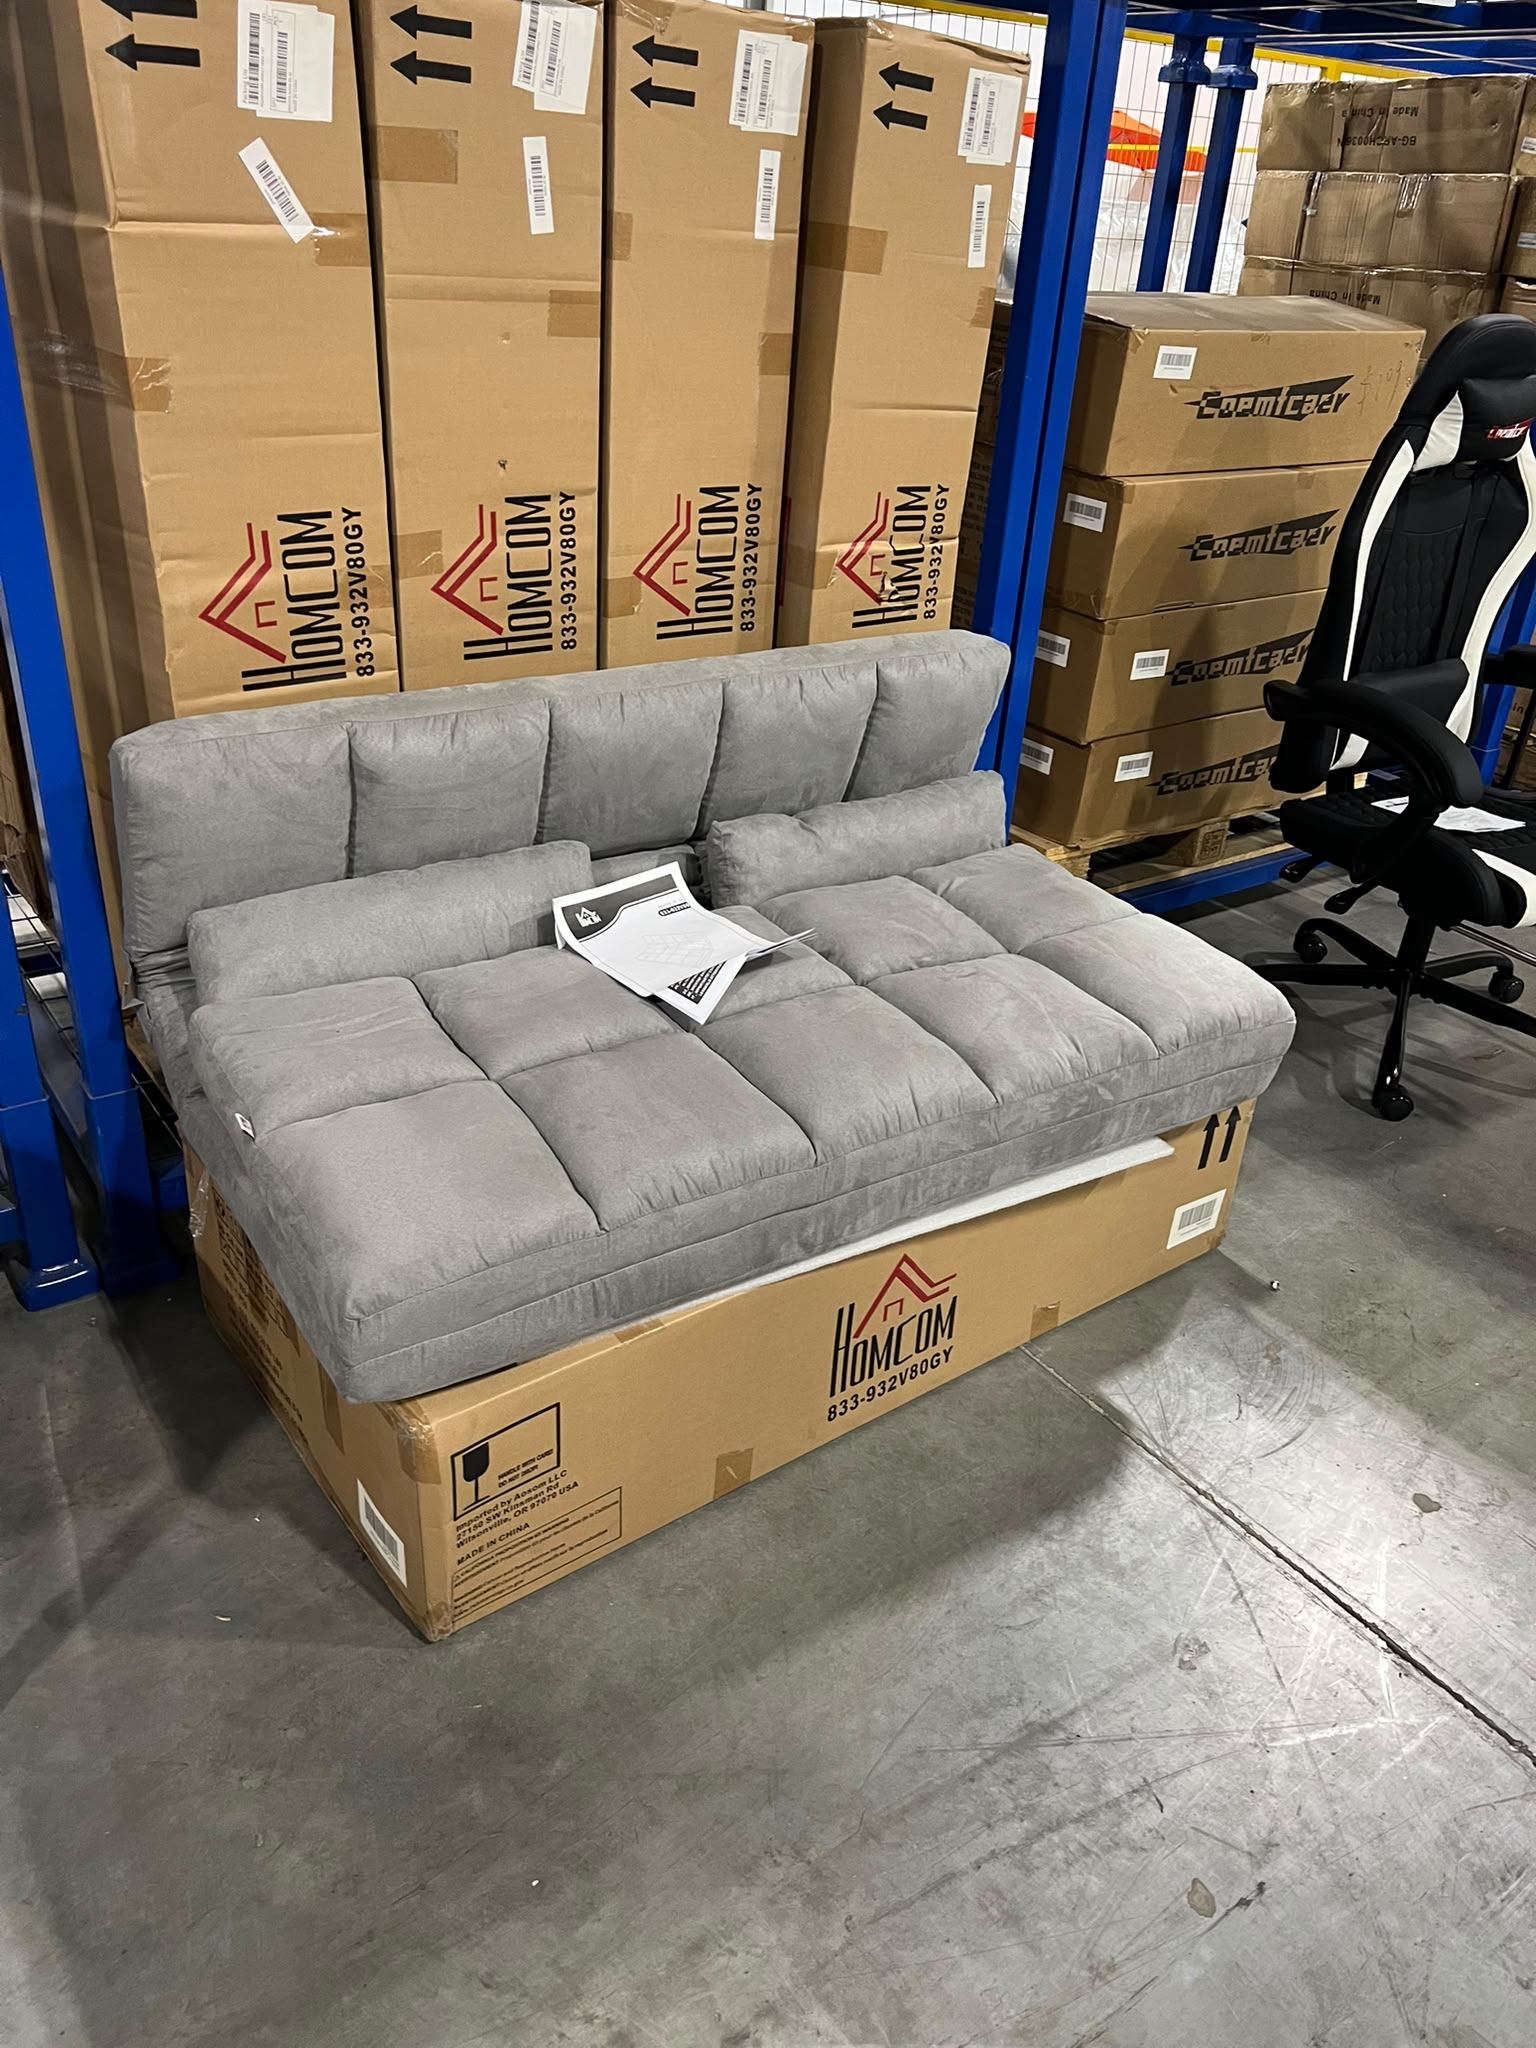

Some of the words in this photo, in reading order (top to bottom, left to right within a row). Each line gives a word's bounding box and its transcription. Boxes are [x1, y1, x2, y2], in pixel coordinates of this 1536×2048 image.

[1392, 106, 1419, 117] Made
[1309, 289, 1338, 301] China
[1356, 294, 1381, 305] Made
[241, 510, 347, 691] HOMCOM
[342, 506, 375, 677] 833-932V80GY
[463, 495, 553, 660] HOMCOM
[559, 491, 577, 650] 833-932V80GY
[656, 486, 740, 640] HOMCOM
[740, 483, 763, 632] 833-932V80GY
[852, 485, 932, 628] HOMCOM
[923, 483, 950, 620] 833-932V80GY
[827, 1345, 954, 1422] 833-932V80GY
[829, 1296, 958, 1398] HOMCOM
[456, 1505, 498, 1531] Imported
[500, 1498, 511, 1508] by
[514, 1480, 546, 1500] Aosom
[548, 1470, 566, 1483] LLC
[456, 1521, 483, 1539] 27150
[486, 1512, 500, 1523] SW
[503, 1490, 543, 1514] Kinsman
[546, 1482, 558, 1492] Rd
[457, 1546, 484, 1564] MADE
[487, 1539, 496, 1547] IN
[499, 1522, 529, 1542] CHINA
[514, 1507, 527, 1517] OR
[559, 1481, 578, 1494] USA
